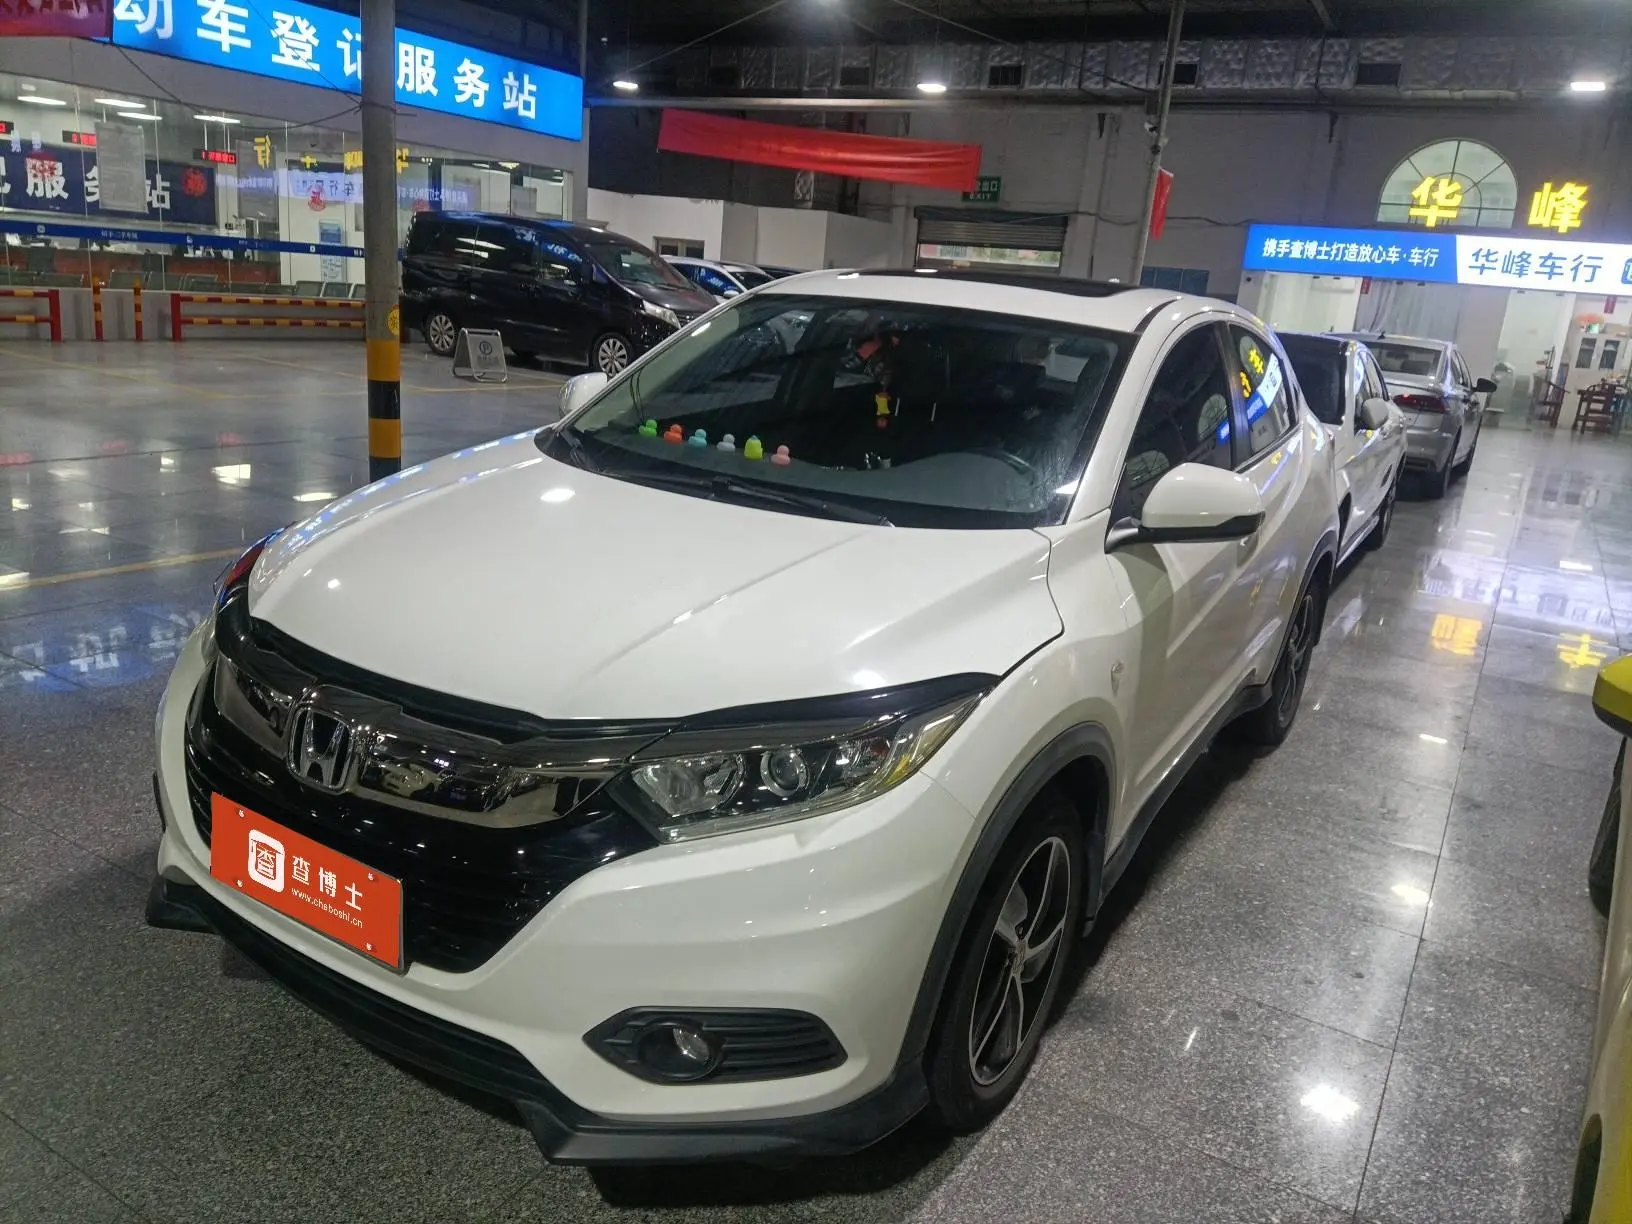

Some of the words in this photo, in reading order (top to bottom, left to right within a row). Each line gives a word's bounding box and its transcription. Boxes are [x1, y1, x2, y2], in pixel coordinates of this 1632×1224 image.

[1408, 176, 1589, 233] 华峰
[1468, 247, 1603, 283] 华峰车行
[291, 854, 363, 912] 查博士
[291, 886, 364, 929] www.chaboshi.cn
